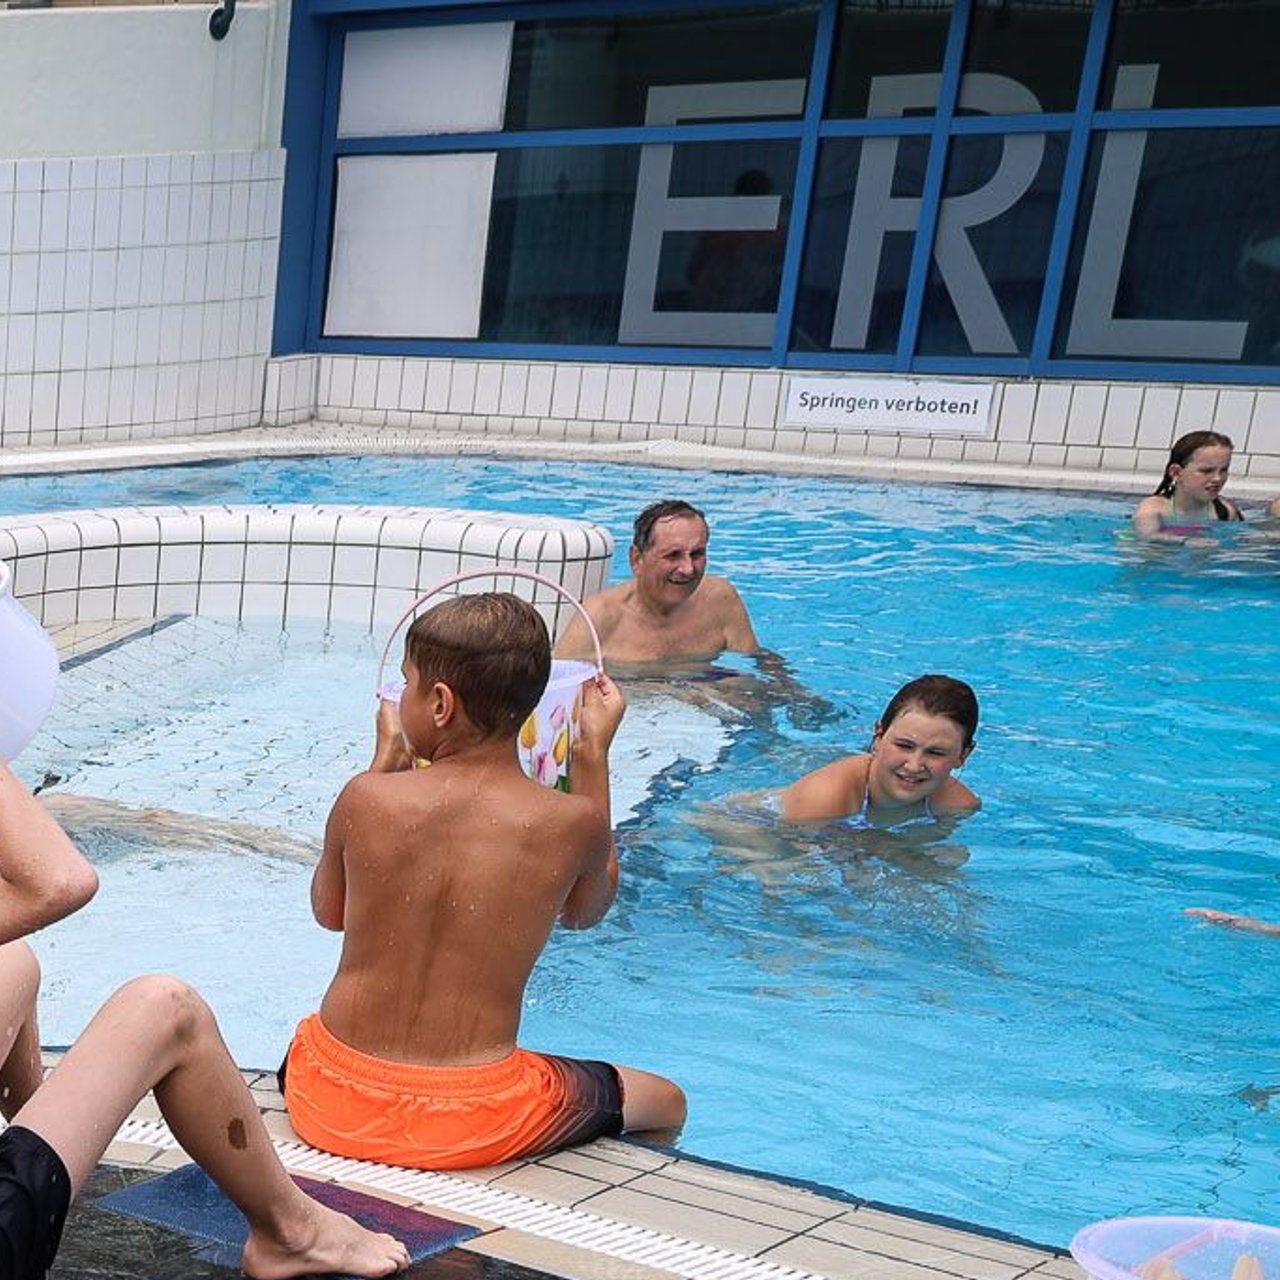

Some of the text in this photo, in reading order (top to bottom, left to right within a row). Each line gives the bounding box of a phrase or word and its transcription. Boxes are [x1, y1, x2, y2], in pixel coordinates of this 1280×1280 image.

[618, 63, 1248, 361] ERL
[798, 391, 980, 415] Springen verboten!
